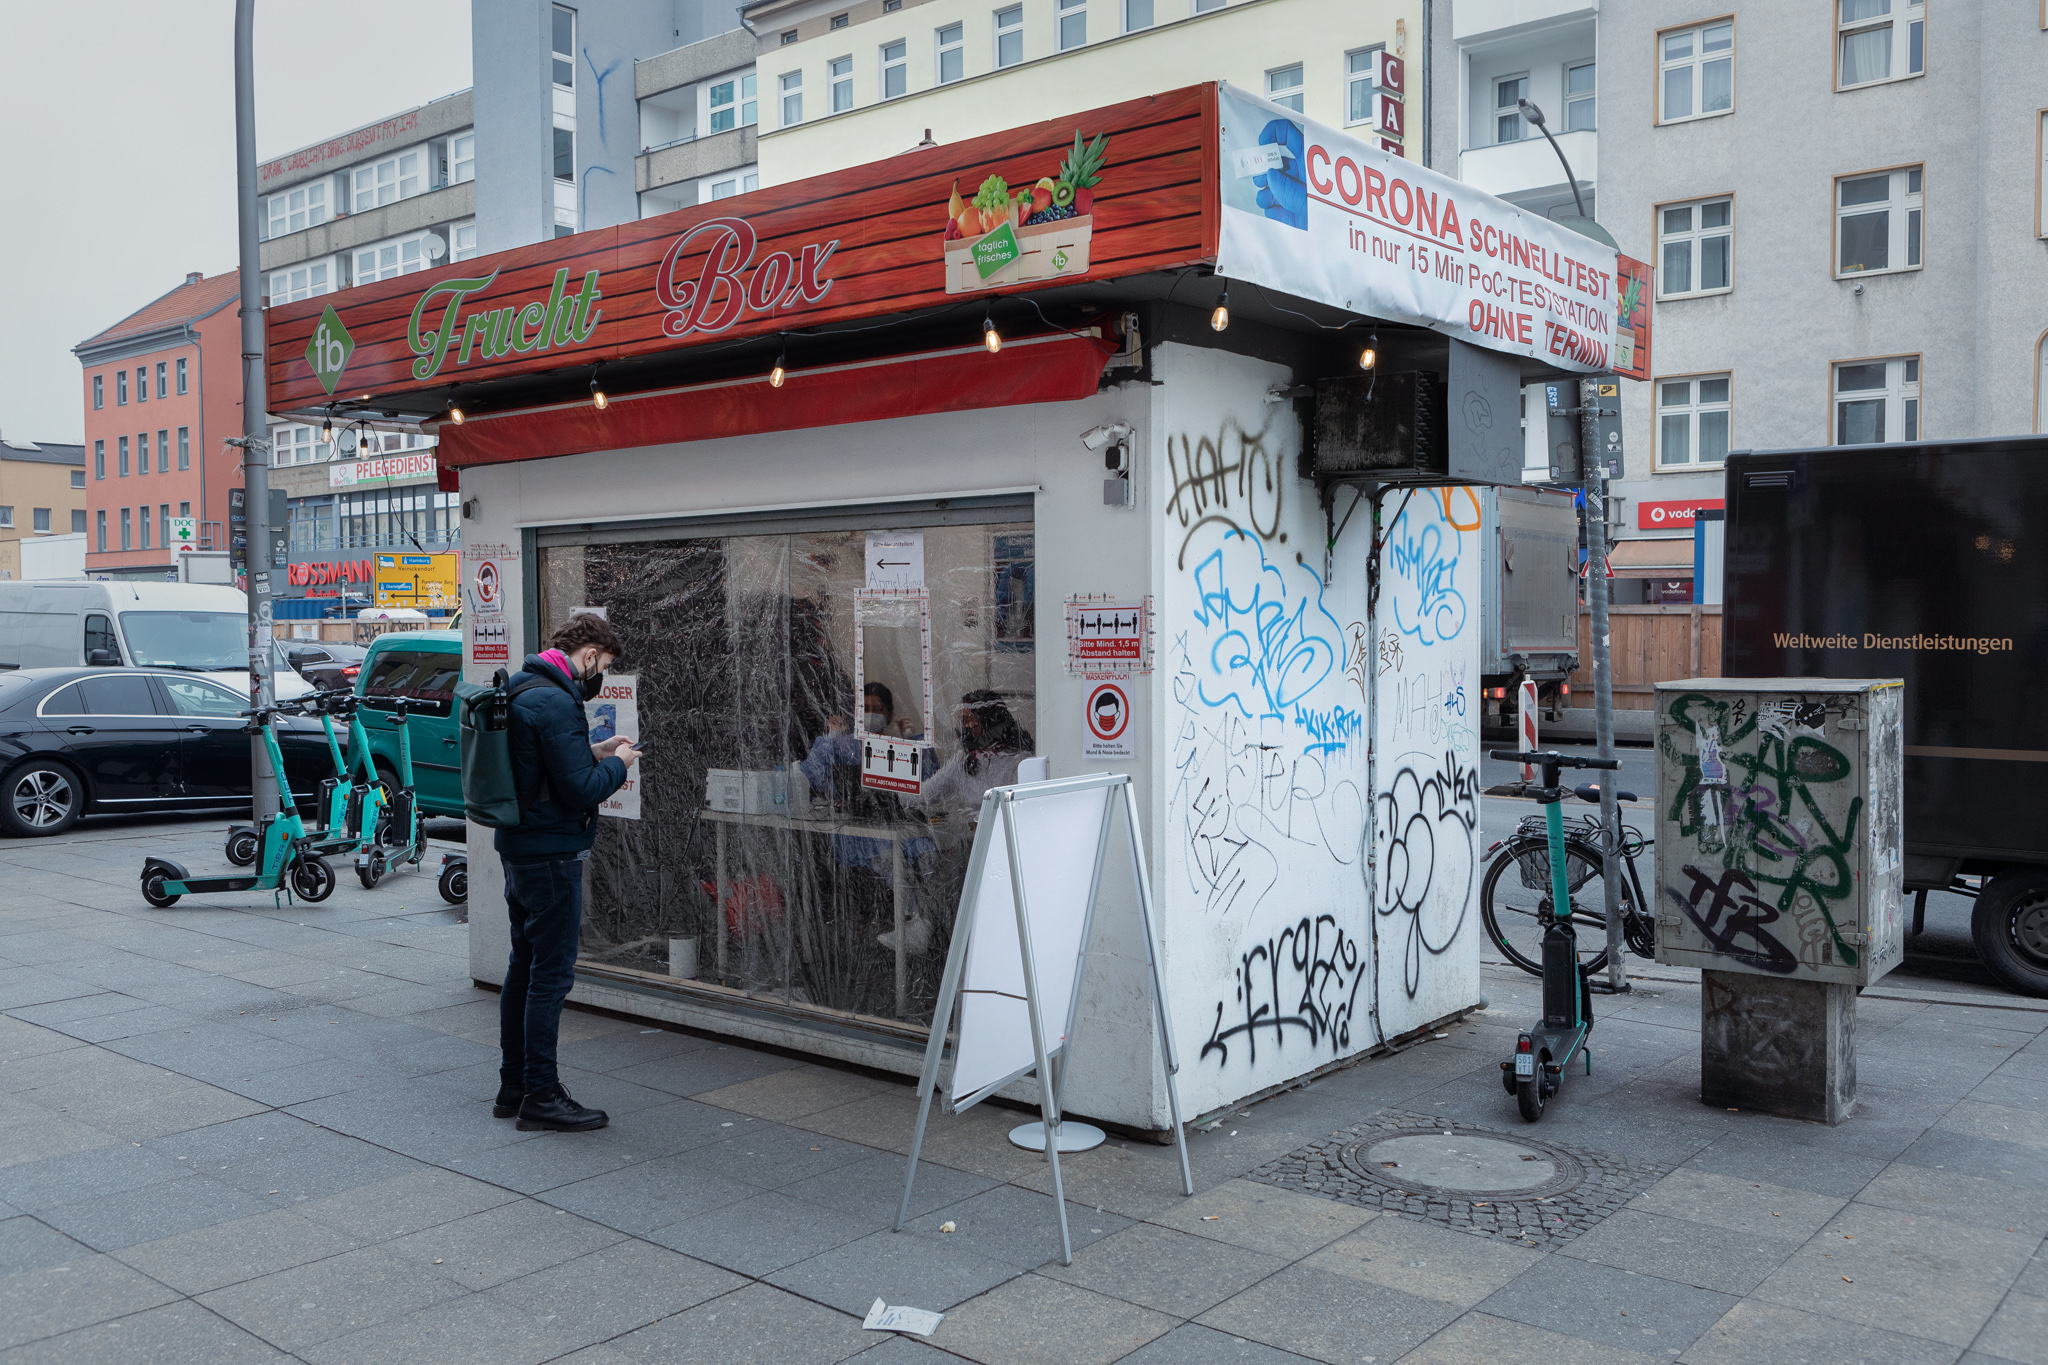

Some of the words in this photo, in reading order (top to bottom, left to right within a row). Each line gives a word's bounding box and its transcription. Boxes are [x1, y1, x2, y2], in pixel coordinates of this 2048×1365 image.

[1306, 144, 1464, 246] CORONA
[1469, 218, 1610, 300] SCHNELLTEST
[978, 239, 1009, 253] täglich
[977, 250, 1012, 266] frisches
[1054, 254, 1066, 266] fb
[1349, 220, 1366, 253] in
[1372, 235, 1401, 264] nur
[1408, 242, 1429, 274] 15
[1435, 250, 1464, 286] Min
[1468, 262, 1609, 336] PoC-TESTSTATION
[407, 264, 602, 381] Frucht
[655, 216, 841, 339] Box
[1469, 298, 1533, 346] OHNE
[1544, 319, 1609, 369] TERMIN
[315, 323, 344, 374] fb
[356, 454, 435, 479] PFLEGEDIENST
[174, 519, 195, 527] DOC
[288, 559, 374, 586] ROSSMANN
[1118, 640, 1130, 648] 1,5
[1773, 632, 1858, 649] Weltweite
[1863, 632, 2013, 655] Dienstleistungen
[595, 686, 633, 700] LOSER
[877, 778, 897, 787] ABSTAND
[338, 803, 347, 825] TIER
[610, 800, 623, 810] Min
[369, 809, 379, 832] TIER
[272, 844, 286, 870] TIER
[1517, 1055, 1532, 1064] 501
